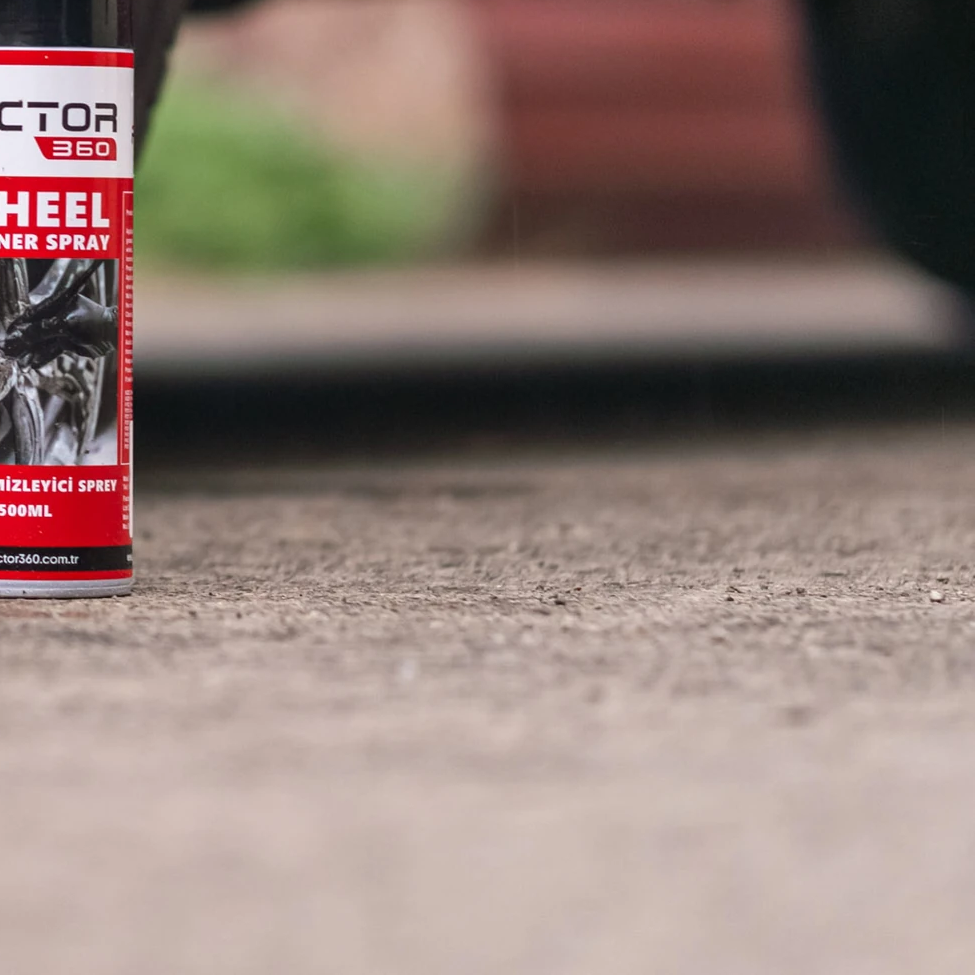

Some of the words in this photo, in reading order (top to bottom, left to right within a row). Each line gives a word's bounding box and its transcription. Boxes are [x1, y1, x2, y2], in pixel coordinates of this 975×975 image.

[52, 140, 110, 157] 360
[45, 233, 110, 251] SPRAY
[78, 479, 118, 492] SPREY
